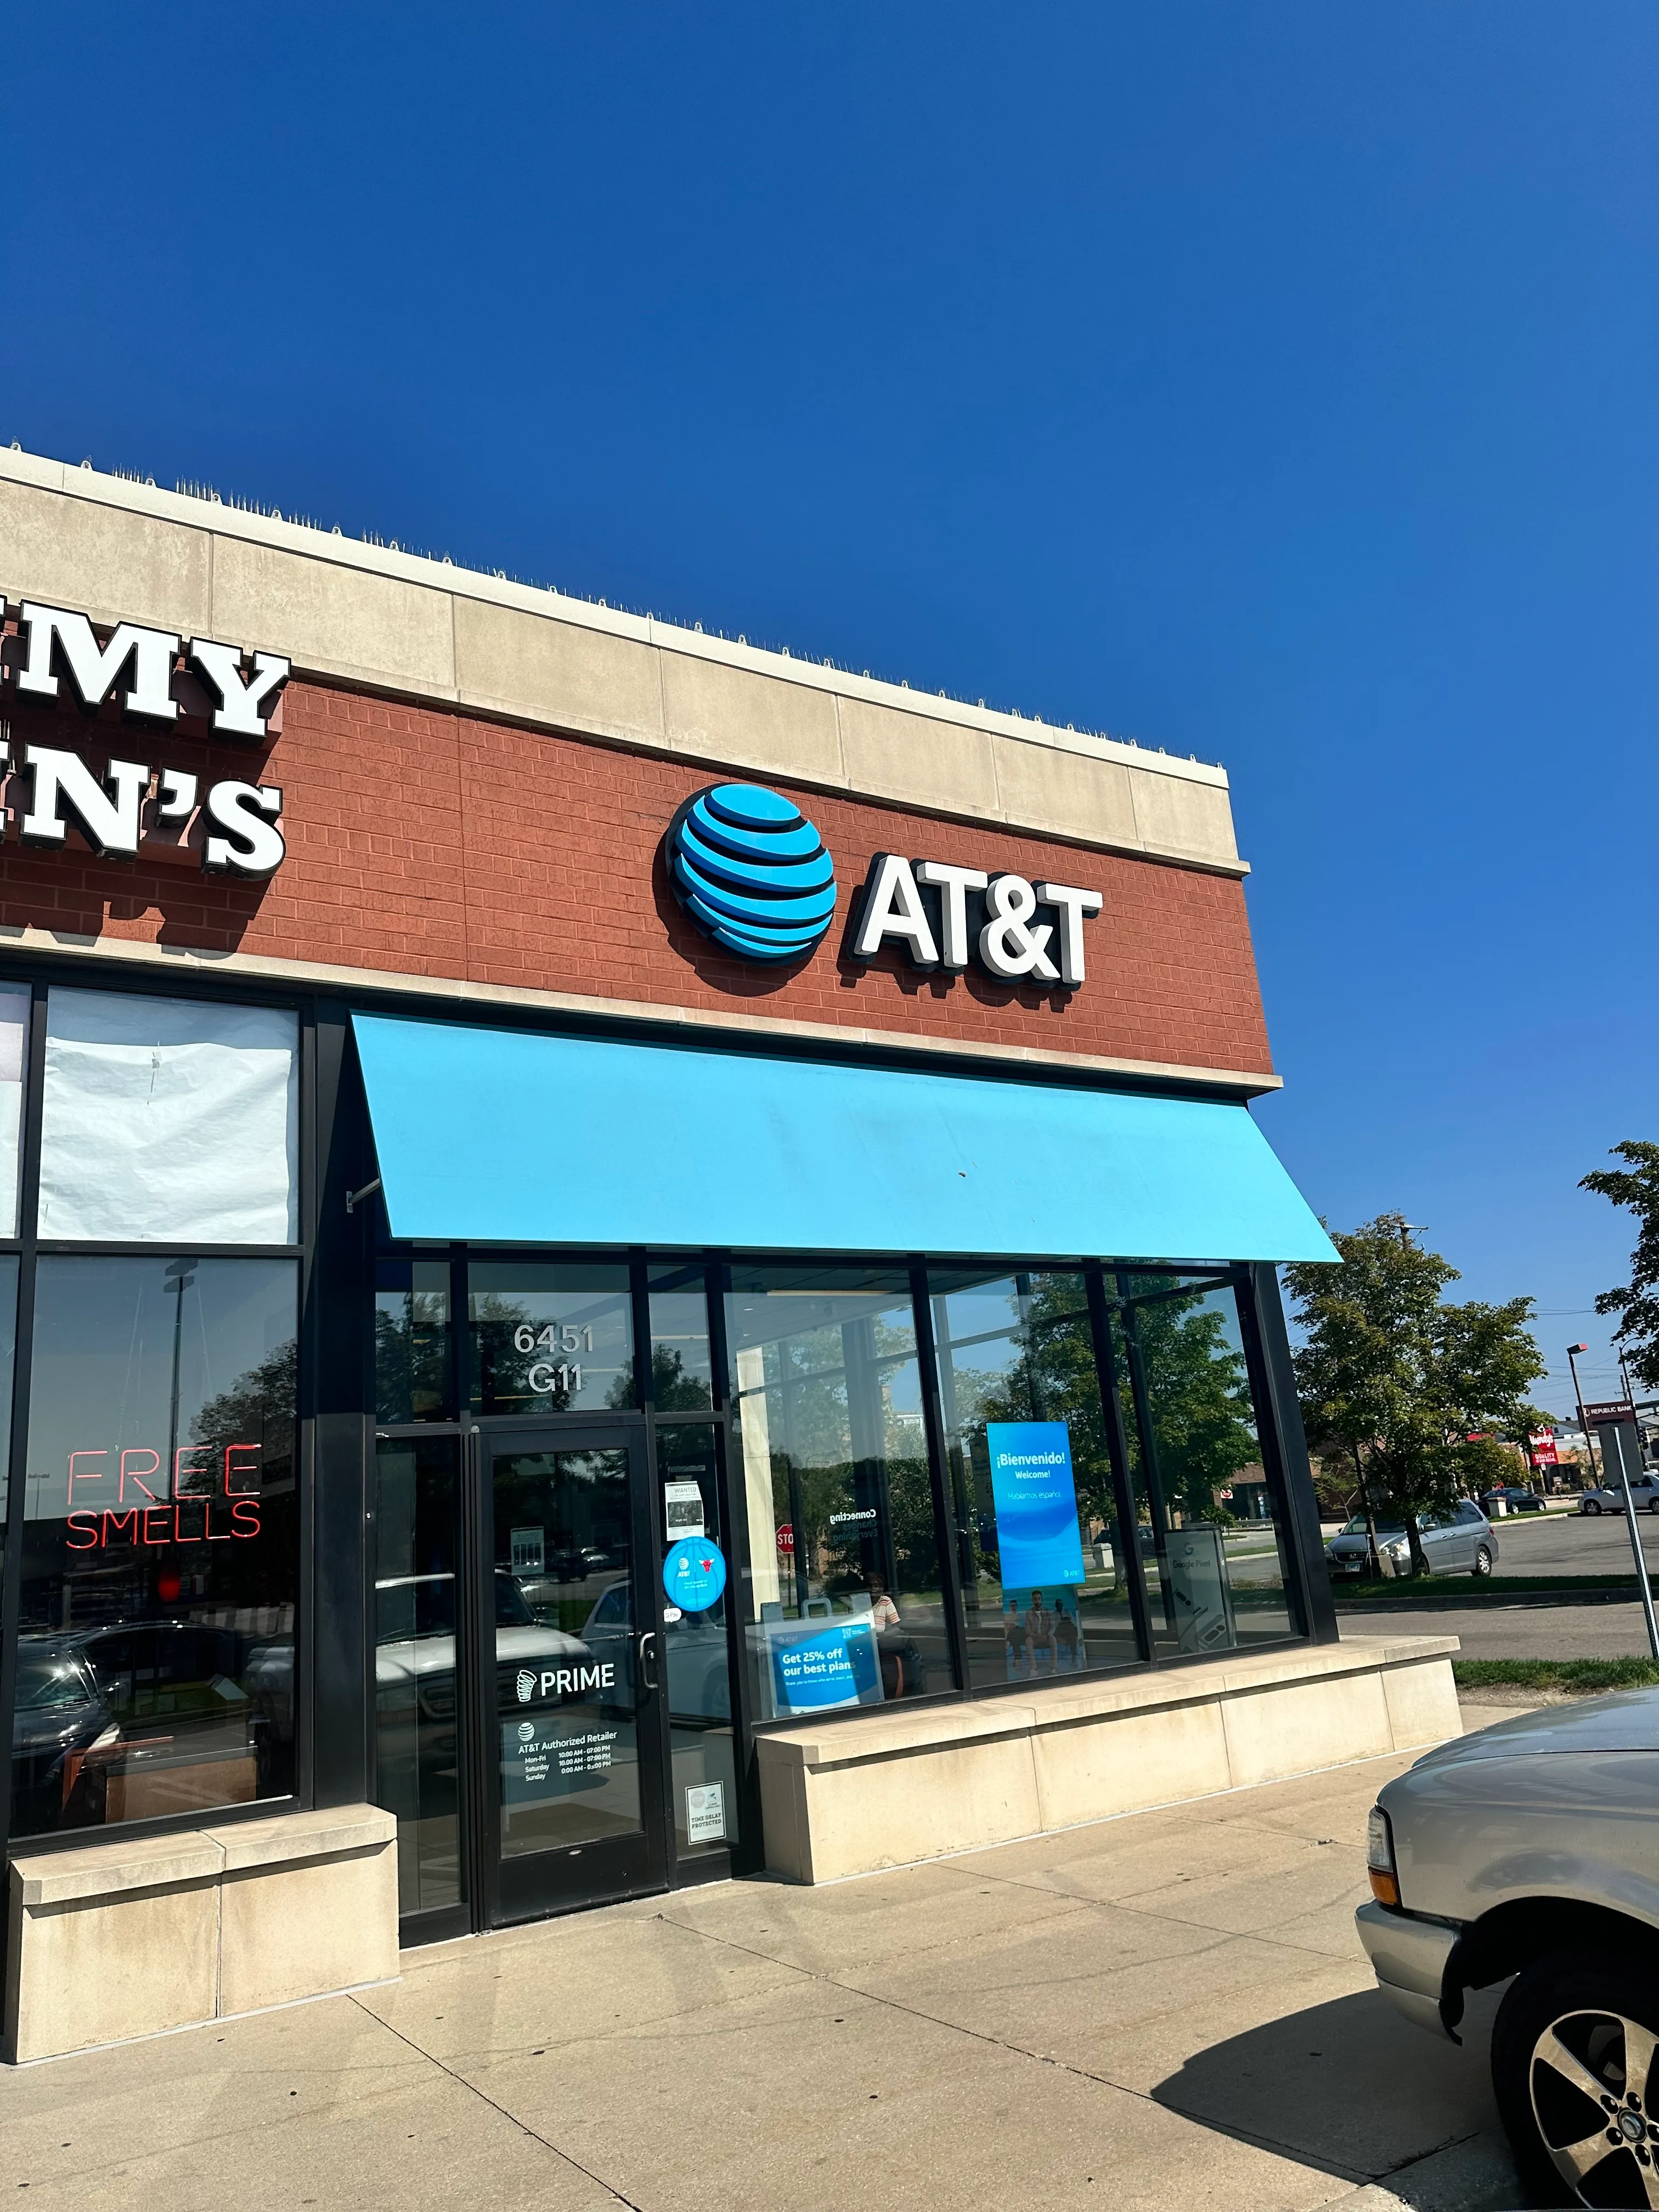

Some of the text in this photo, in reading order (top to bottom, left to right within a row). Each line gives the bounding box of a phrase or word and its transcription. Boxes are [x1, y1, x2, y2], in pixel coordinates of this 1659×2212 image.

[0, 595, 291, 741] MY
[0, 738, 286, 876] N'S
[854, 855, 1103, 985] AT&T
[514, 1325, 594, 1353] 6451
[528, 1363, 582, 1392] G11
[996, 1452, 1065, 1468] ¡Bienvenido!
[67, 1444, 262, 1505] FREE
[1014, 1470, 1051, 1479] Welcome!
[1008, 1491, 1037, 1500] Hablamos
[66, 1501, 261, 1549] SMELLS
[777, 1534, 793, 1545] STO
[1173, 1560, 1194, 1570] Google
[782, 1648, 843, 1664] Get 25% off
[783, 1661, 856, 1677] our best plans
[541, 1663, 615, 1696] PRIME
[518, 1731, 618, 1754] AT&T Authorized Retailer
[524, 1754, 546, 1764] Mon-Fri
[524, 1763, 550, 1773] Saturday
[525, 1773, 546, 1781] Sunday
[691, 1819, 722, 1829] PROTECTED
